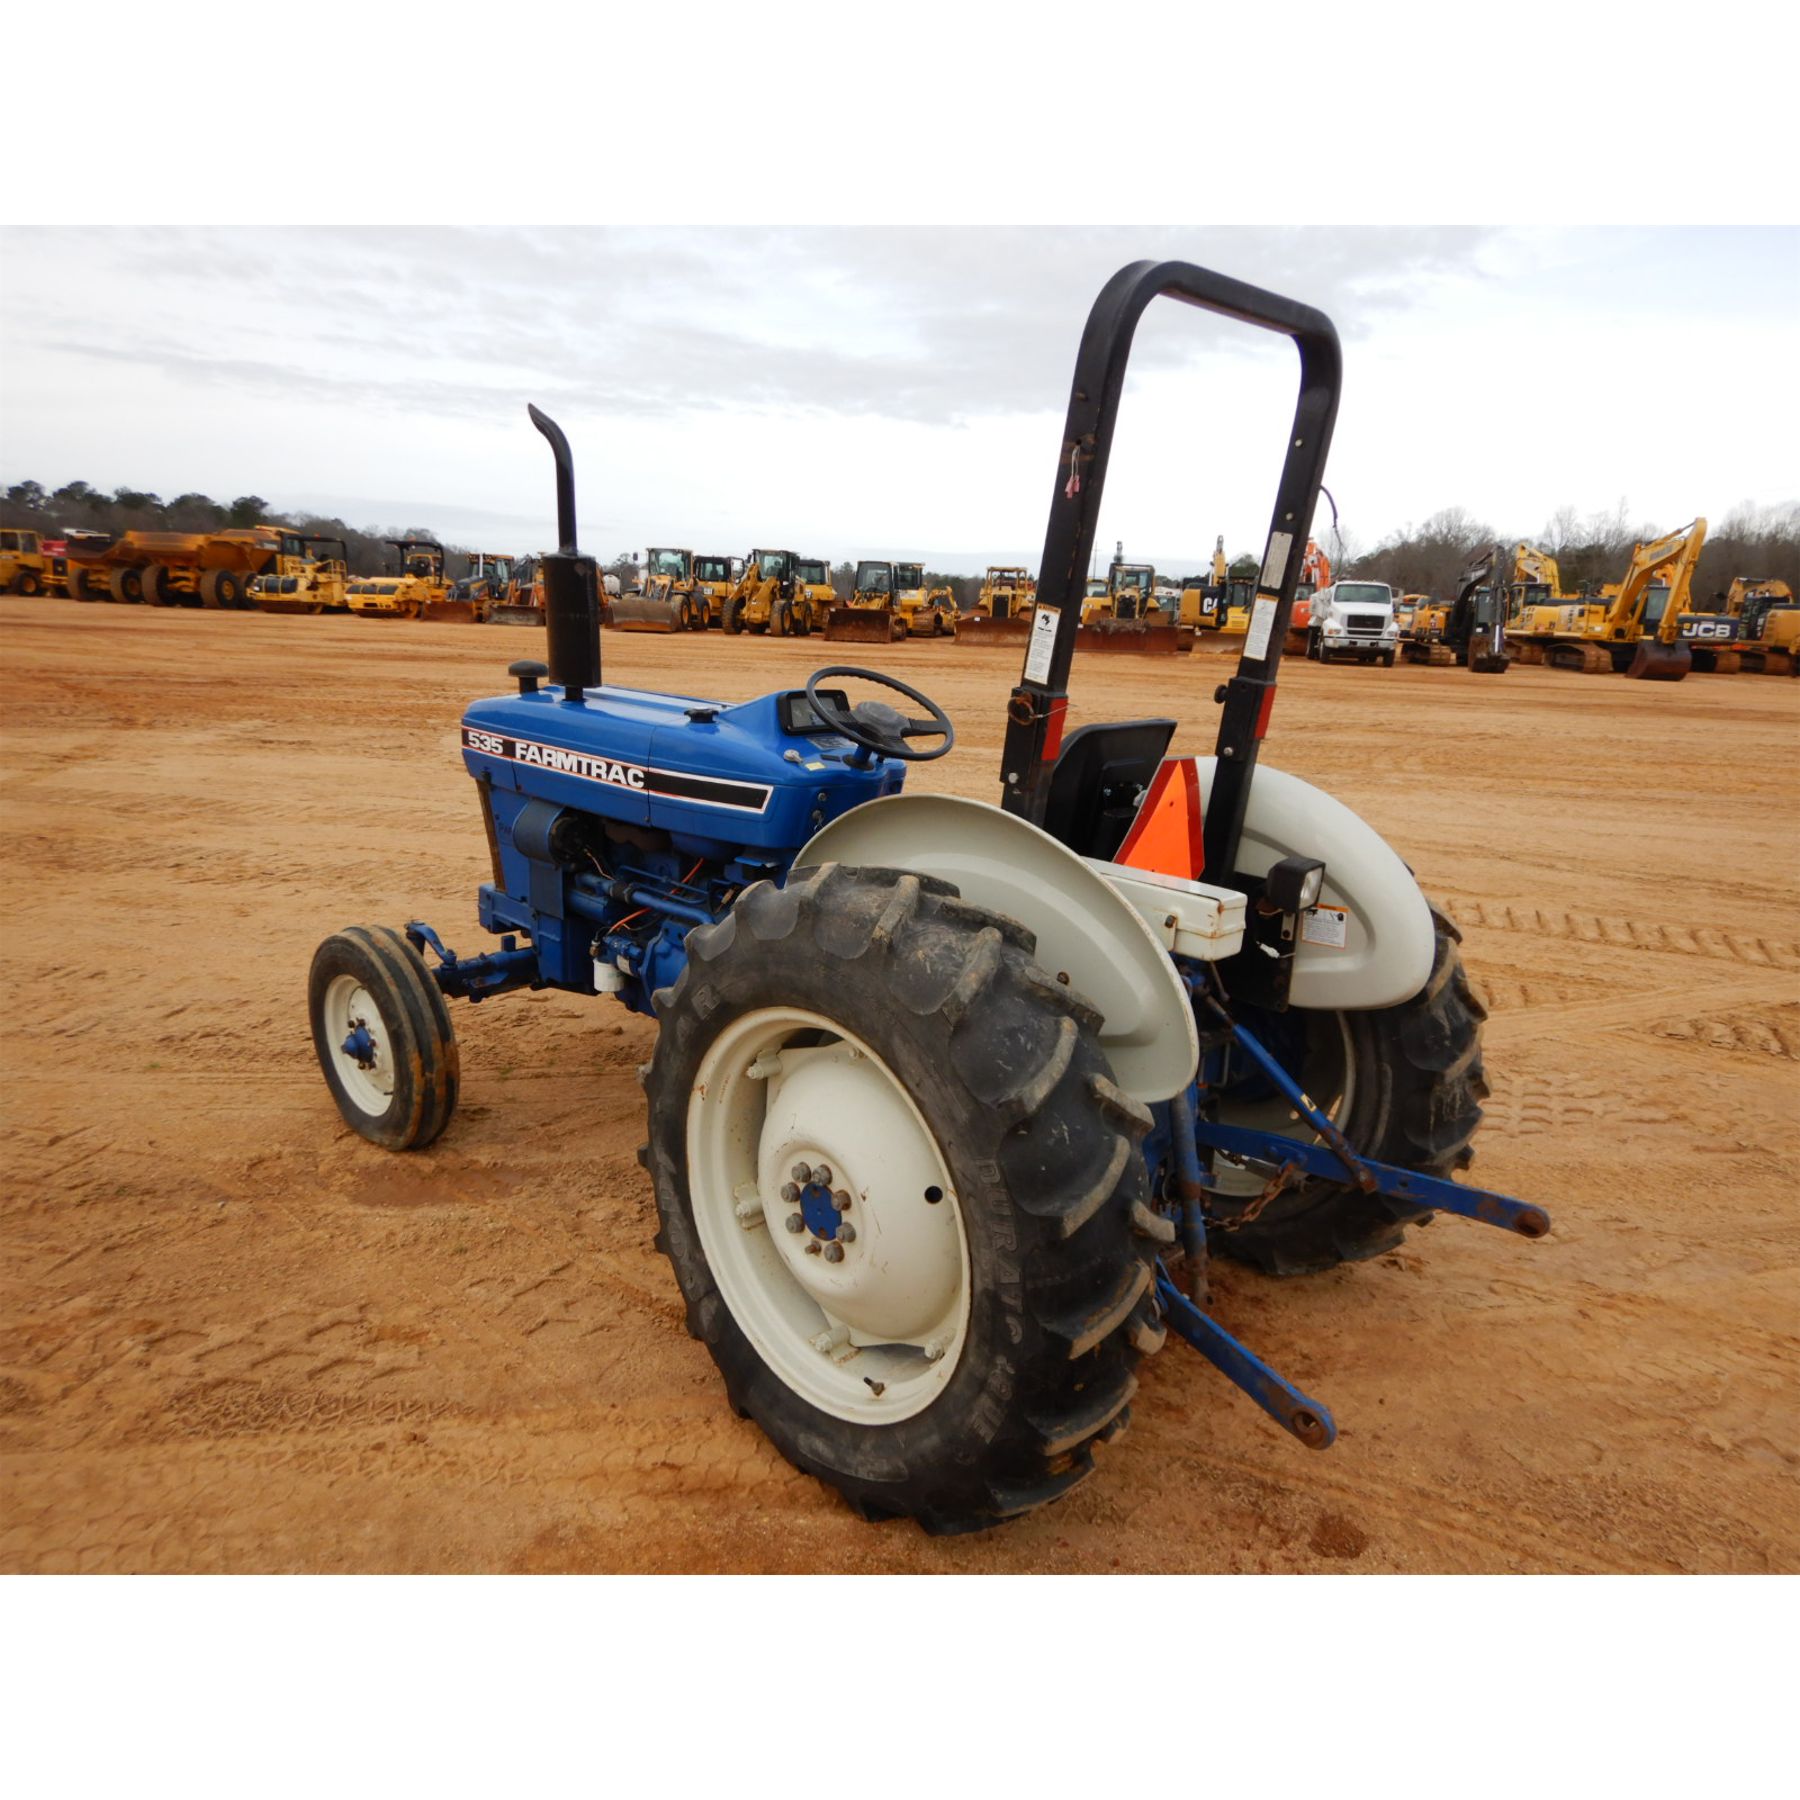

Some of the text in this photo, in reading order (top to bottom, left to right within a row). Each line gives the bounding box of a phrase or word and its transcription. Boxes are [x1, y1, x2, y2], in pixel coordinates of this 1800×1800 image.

[1203, 597, 1218, 613] CA
[1682, 623, 1731, 637] JCB
[468, 731, 645, 788] 535 FARMTRAC
